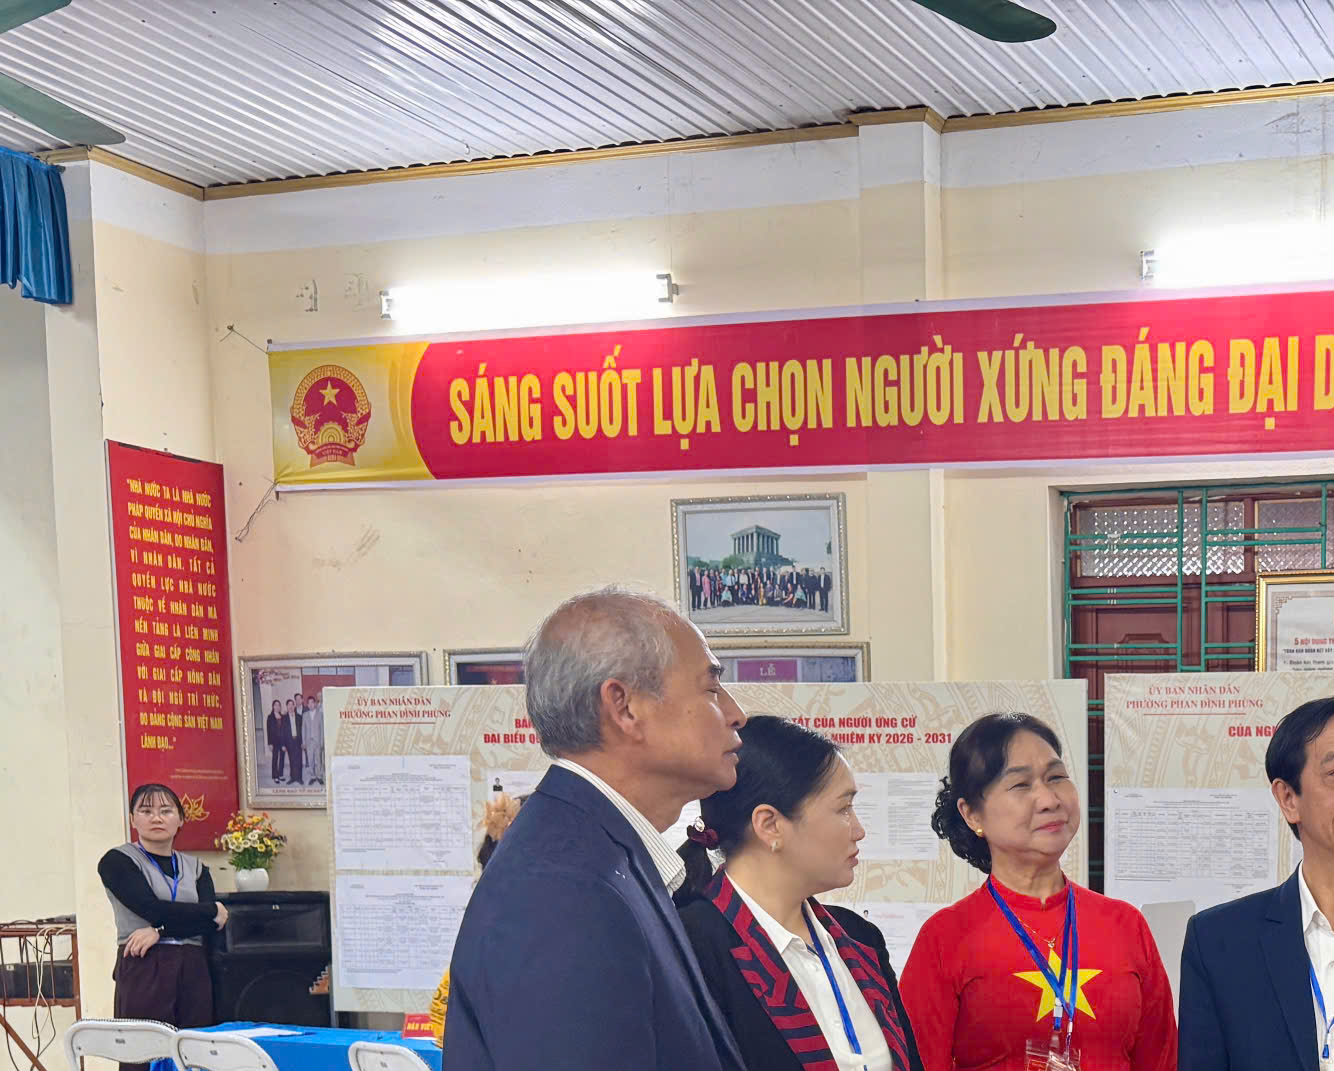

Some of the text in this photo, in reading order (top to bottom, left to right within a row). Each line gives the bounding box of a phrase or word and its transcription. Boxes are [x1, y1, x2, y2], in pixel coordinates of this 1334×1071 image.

[450, 363, 542, 445] SÁNG
[553, 346, 642, 440] SUỐT
[652, 355, 721, 450] LỰA
[731, 359, 833, 446] CHỌN
[845, 335, 964, 427] NGƯỜI
[976, 333, 1087, 423] XỨNG
[1099, 327, 1214, 419] ĐÁNG
[1227, 335, 1299, 430] ĐẠI
[1148, 683, 1240, 695] ỦY BAN NHÂN DÂN
[357, 695, 432, 706] ỦY BAN NHÂN DÂN
[1126, 698, 1264, 709] PHƯỜNG PHAN ĐÌNH PHÙNG
[339, 708, 451, 719] PHƯỜNG PHAN ĐÌNH PHÙNG
[814, 714, 836, 728] CỦA
[839, 714, 872, 728] NGƯỜI
[875, 714, 898, 728] ỨNG
[901, 714, 917, 728] CỬ
[1228, 723, 1253, 737] CỦA
[483, 733, 500, 746] ĐẠI
[503, 730, 526, 744] BIỂU
[885, 733, 914, 744] 2026
[925, 733, 952, 744] 2031
